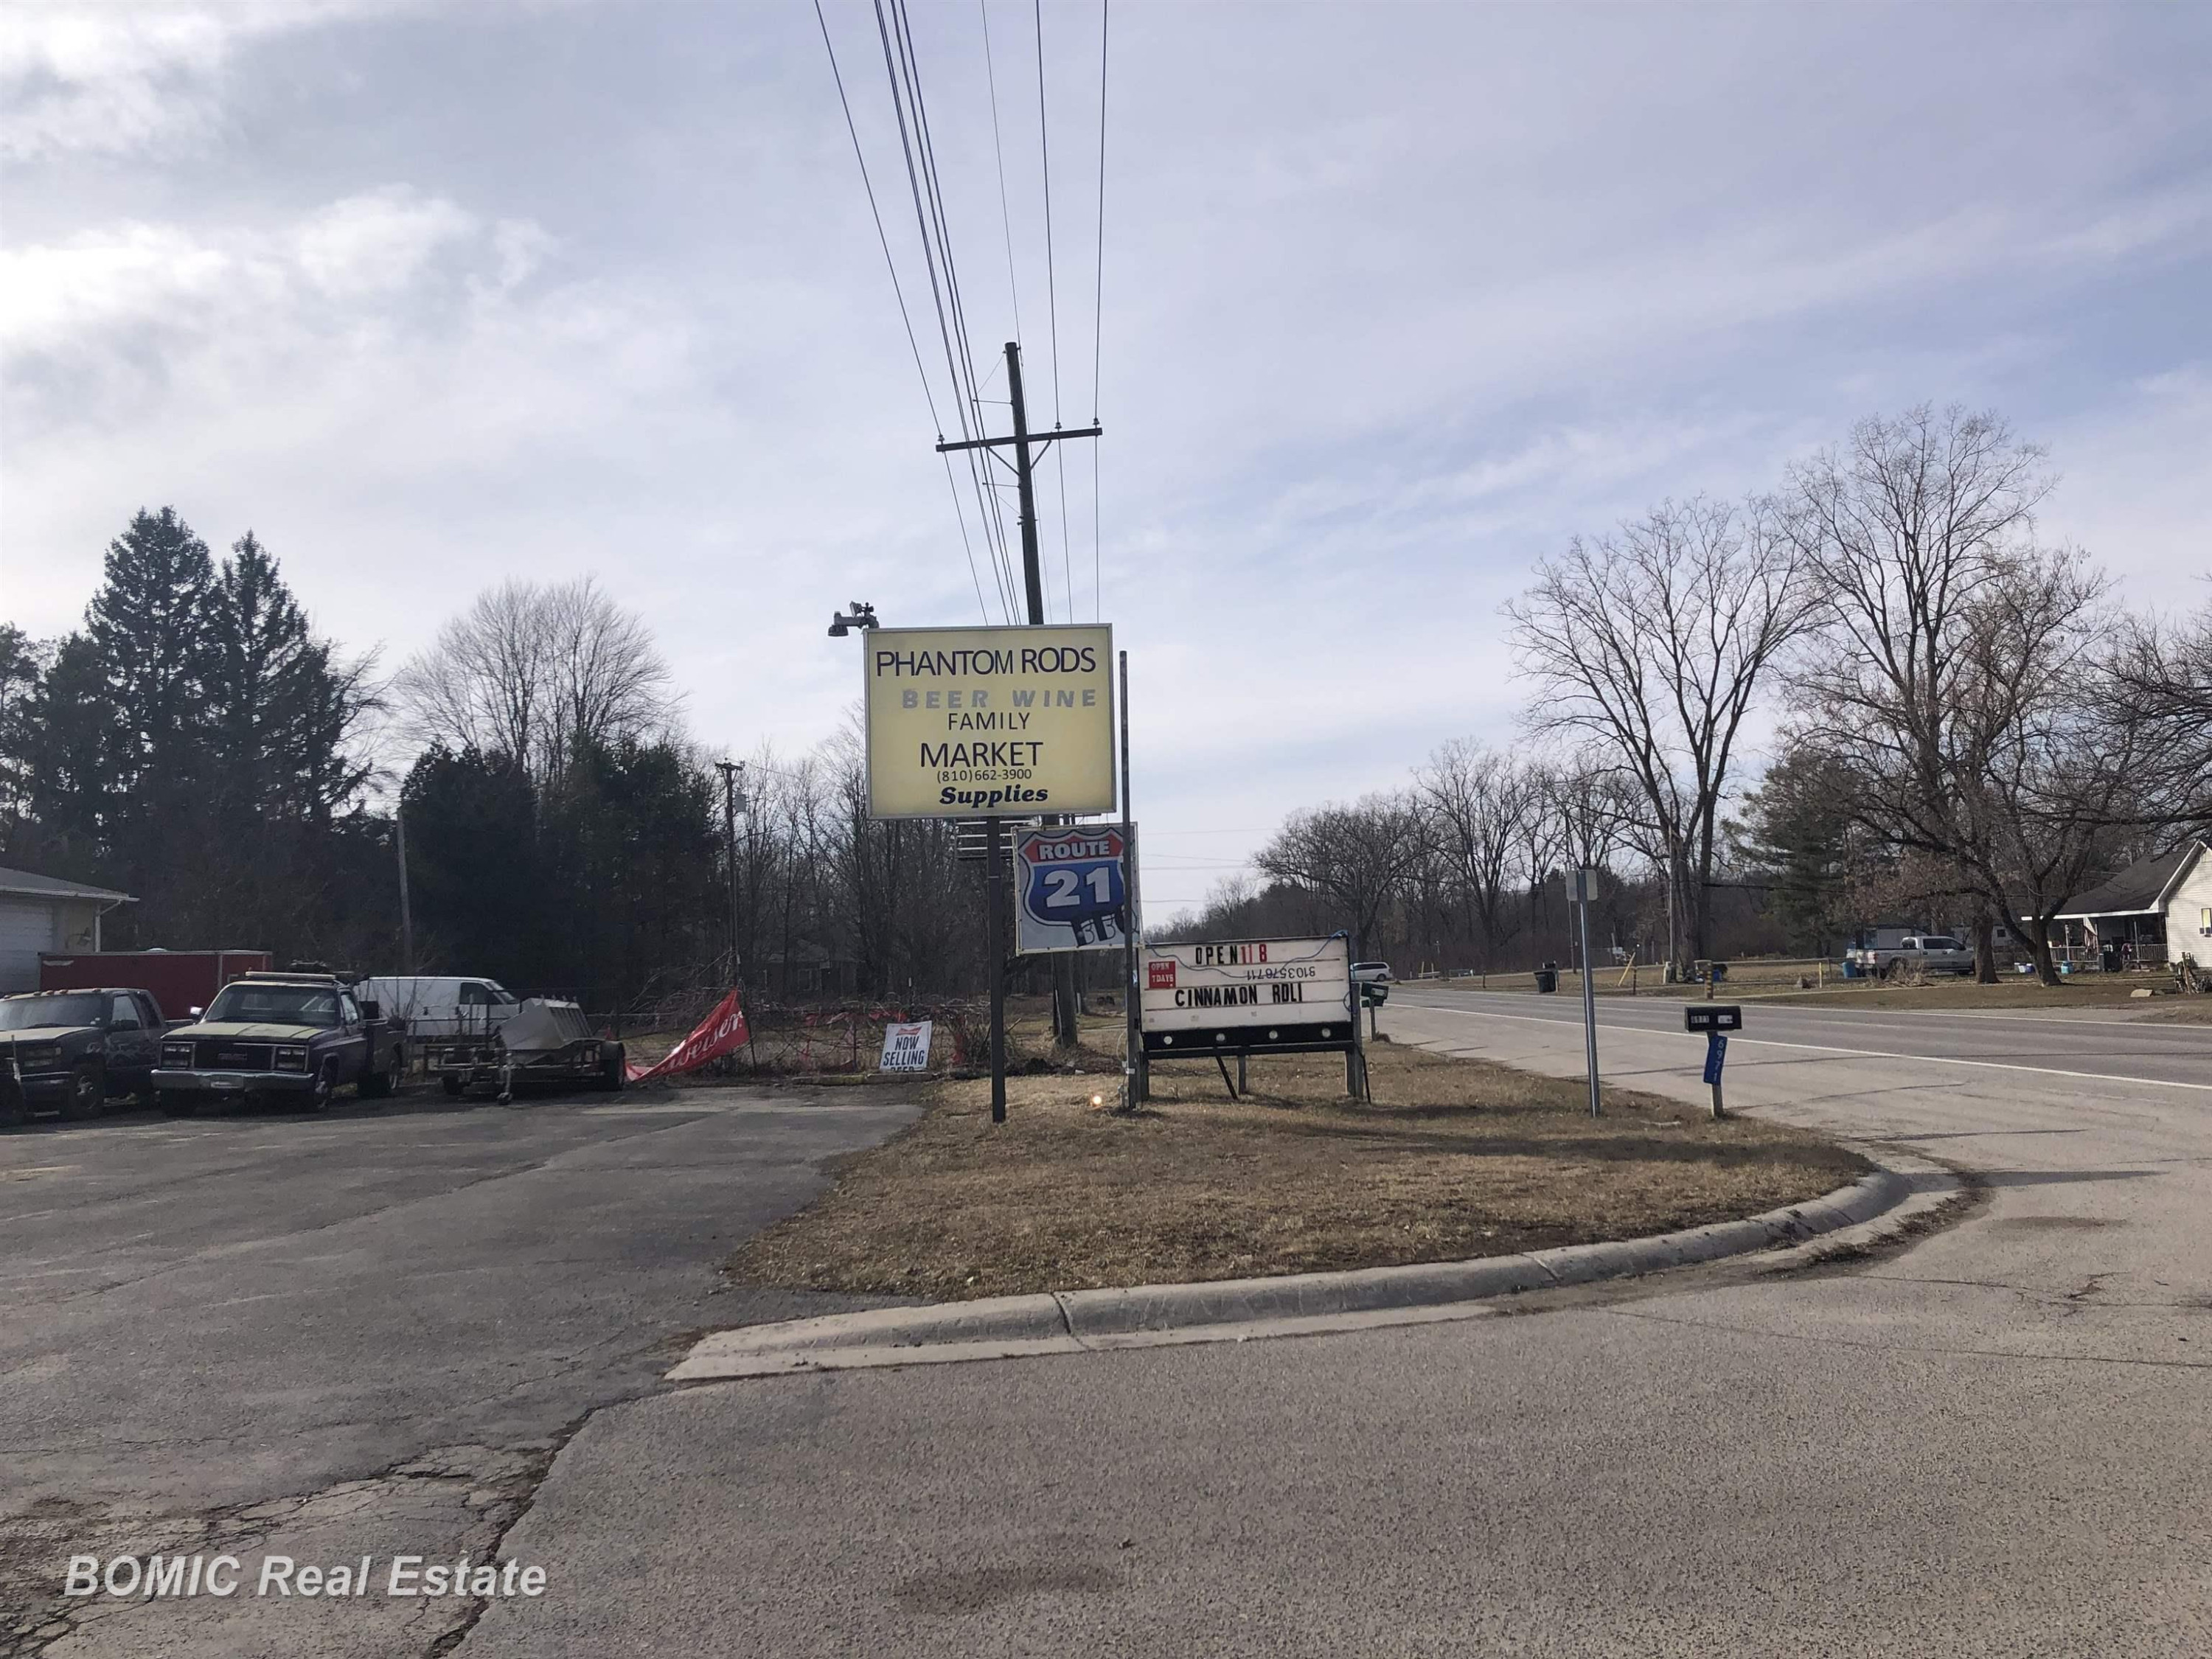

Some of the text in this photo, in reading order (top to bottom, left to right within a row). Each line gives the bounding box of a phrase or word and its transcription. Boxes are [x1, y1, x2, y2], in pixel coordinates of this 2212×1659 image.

[876, 647, 1096, 676] PHANTOM RODS
[902, 689, 1096, 709] BEER WINE
[948, 712, 1031, 731] FAMILY
[921, 742, 1043, 767] MARKET
[937, 768, 1032, 784] (810)662-3900
[939, 785, 1048, 808] Supplies
[1039, 841, 1110, 860] ROUTE
[1044, 866, 1110, 908] 21
[1195, 945, 1238, 965] OPEN
[1151, 962, 1170, 971] OPEN
[1175, 984, 1258, 1006] CINNAMON
[894, 1036, 919, 1051] NOW
[883, 1050, 925, 1066] SELLING
